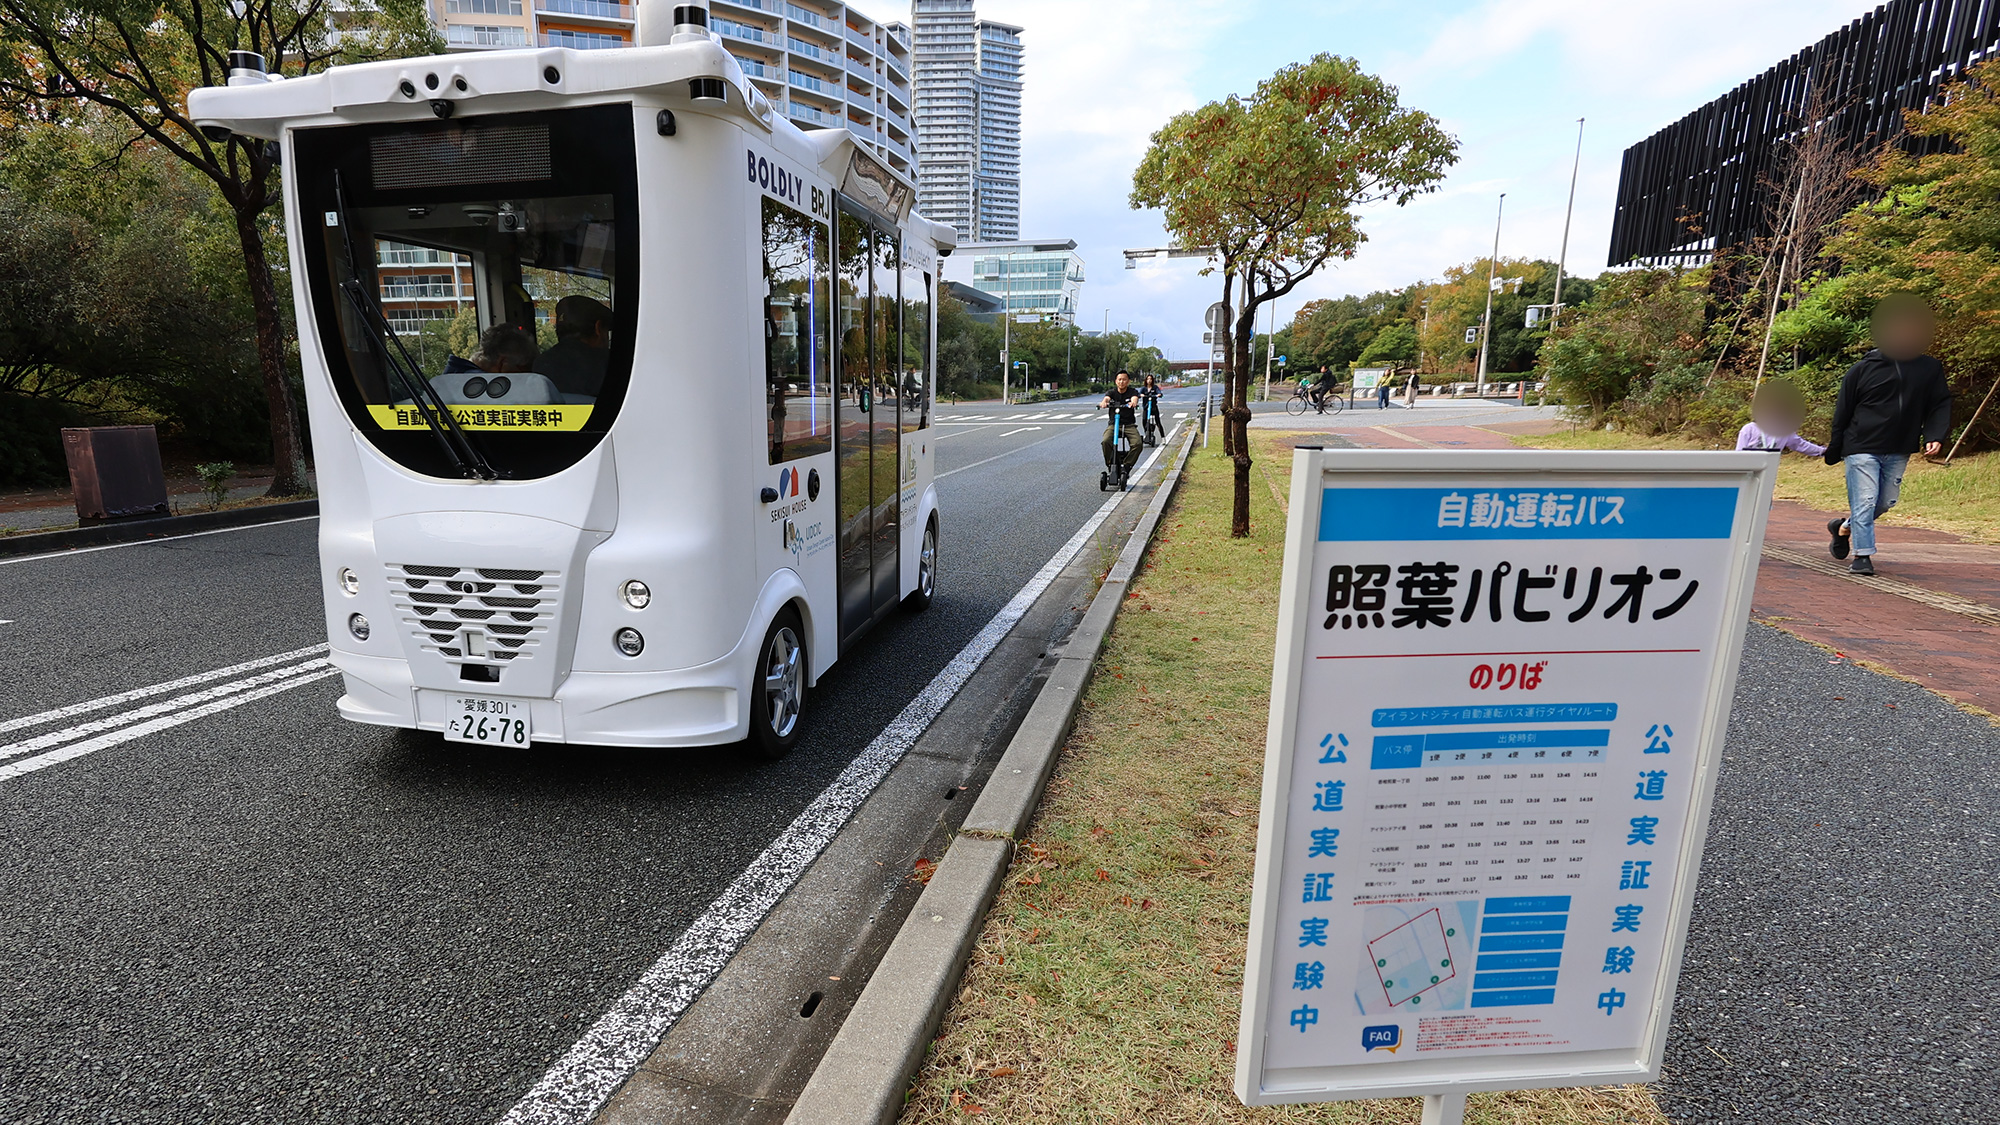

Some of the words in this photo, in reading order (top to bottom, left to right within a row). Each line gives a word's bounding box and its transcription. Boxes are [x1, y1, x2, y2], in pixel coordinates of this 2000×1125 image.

[748, 149, 802, 206] BOLDLY
[457, 410, 563, 427] 公道実証実験中
[771, 505, 791, 523] SEKISUI
[792, 500, 806, 514] HOUSE
[1438, 492, 1625, 528] 自動運転バス
[1324, 561, 1699, 630] 照葉パビリオン
[1470, 661, 1548, 690] のりば
[1376, 706, 1614, 723] アイランドシティ自動運転バス運行ダイヤ/ルート
[449, 720, 459, 731] た
[463, 715, 525, 744] 26-78
[1498, 734, 1536, 743] 出発時刻
[1384, 745, 1412, 754] バス停
[1429, 753, 1441, 762] 1便
[1453, 752, 1466, 760] 2便
[1480, 752, 1493, 760] 3便
[1506, 751, 1519, 759] 4便
[1534, 750, 1546, 758] 5便
[1561, 749, 1573, 757] 6便
[1587, 748, 1600, 756] 7便
[1597, 723, 1673, 1016] 公道実証実験中
[1290, 733, 1349, 1033] 公道実証実験中
[1369, 1030, 1392, 1042] FAQ
